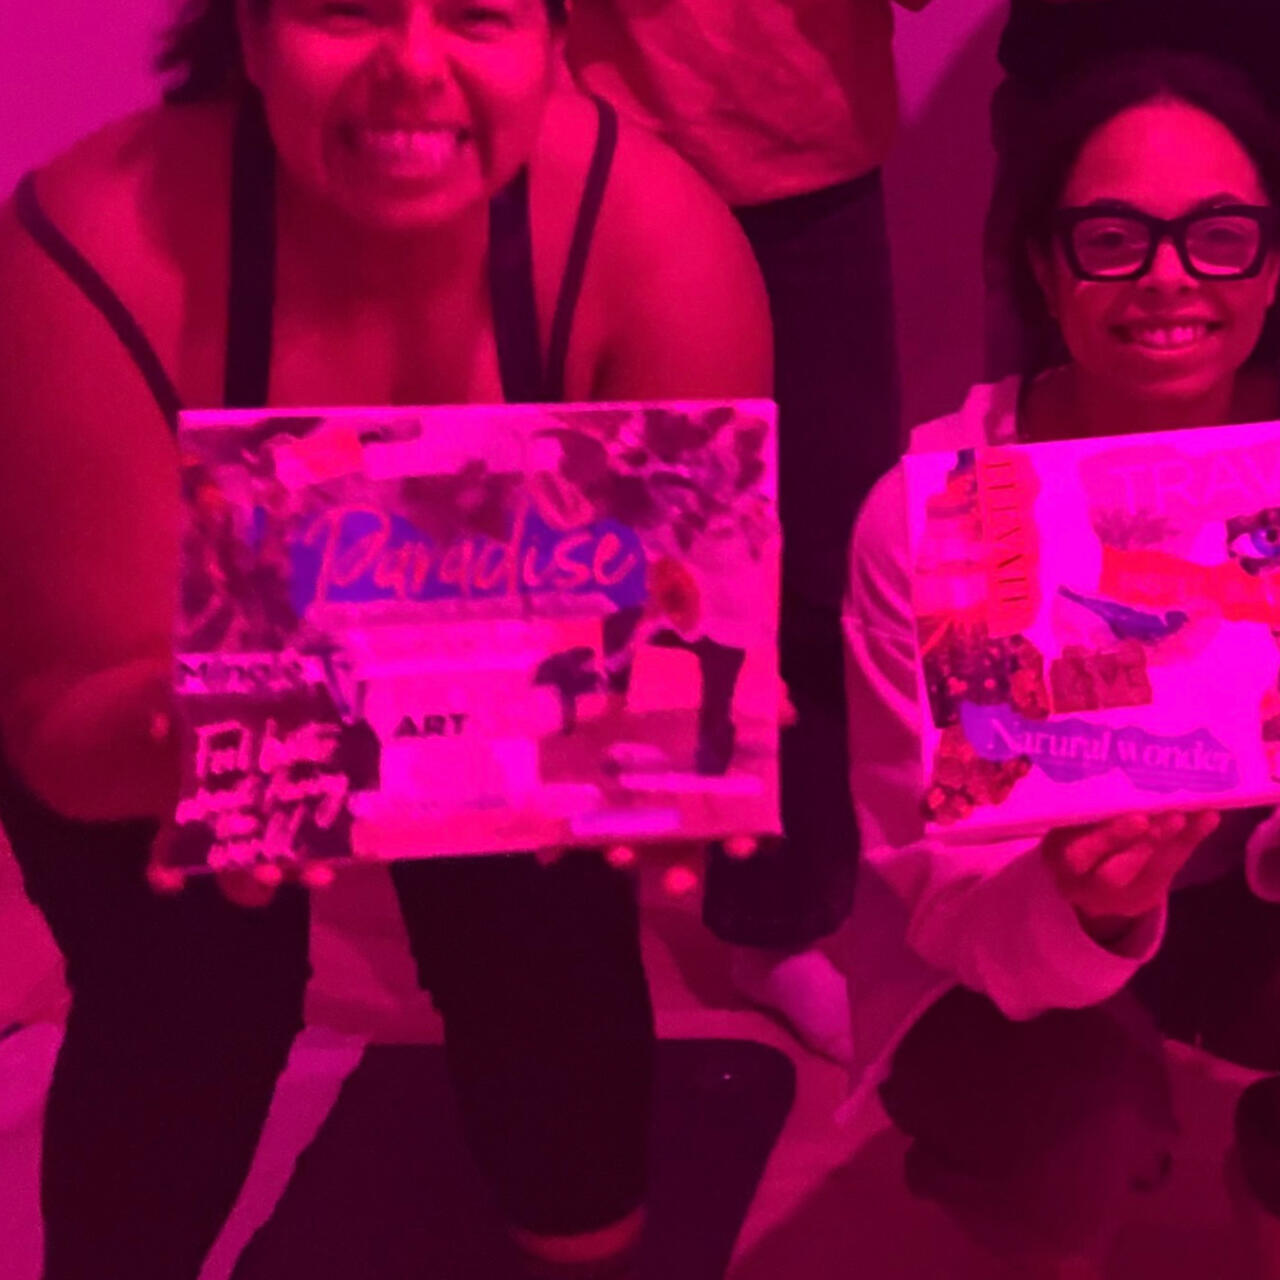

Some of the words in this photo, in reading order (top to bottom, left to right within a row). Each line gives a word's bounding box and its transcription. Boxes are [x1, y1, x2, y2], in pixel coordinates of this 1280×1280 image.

[300, 503, 639, 603] Paradise
[393, 713, 468, 737] ART
[987, 718, 1112, 761] Natural
[1116, 737, 1232, 774] wonder
